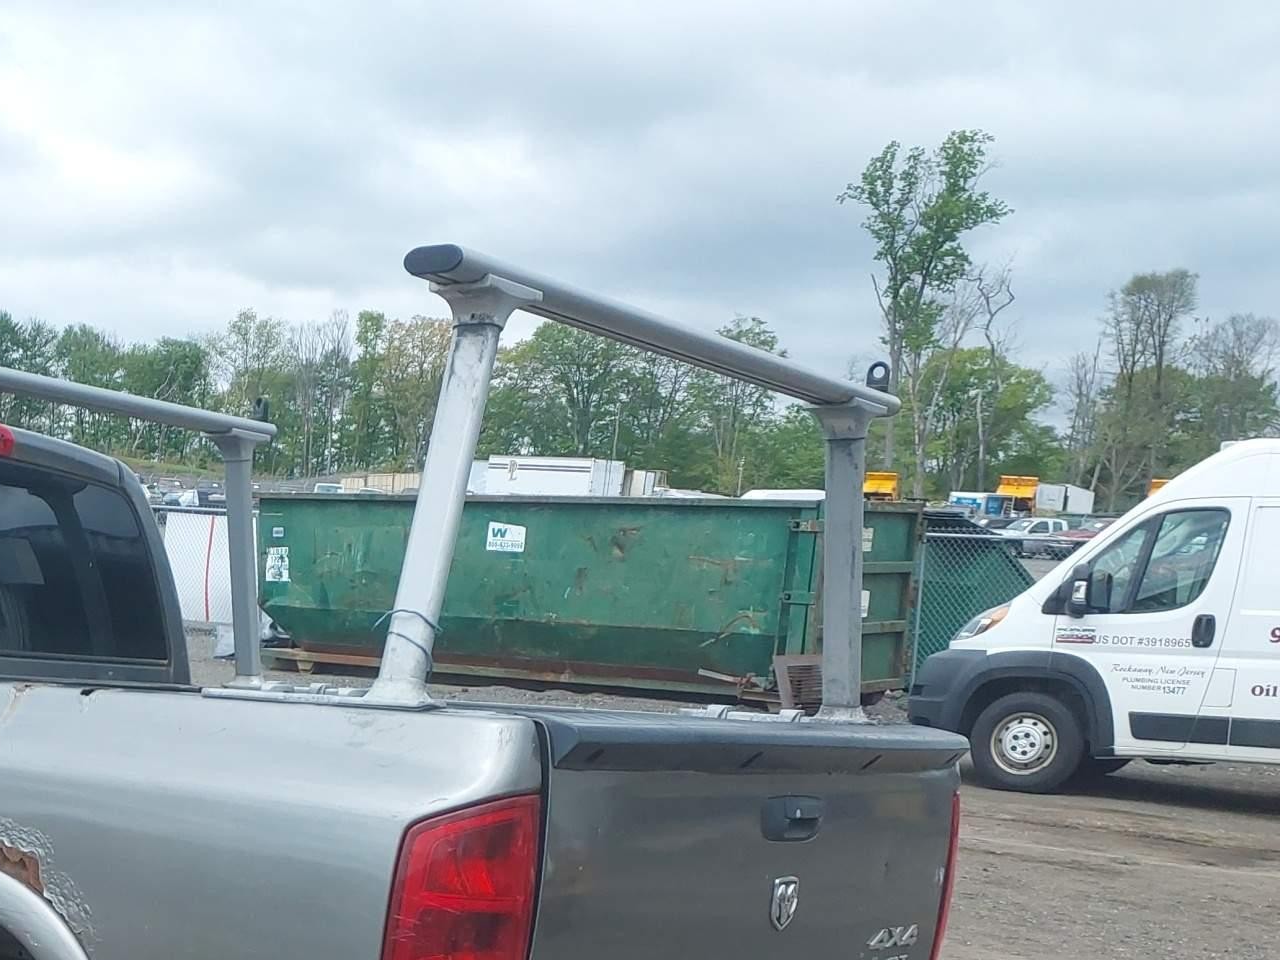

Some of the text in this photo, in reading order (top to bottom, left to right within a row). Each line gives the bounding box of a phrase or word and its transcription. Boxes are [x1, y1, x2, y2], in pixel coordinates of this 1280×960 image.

[1093, 634, 1110, 644] US
[1112, 635, 1136, 645] DOT
[1137, 637, 1191, 648] #3918965
[1156, 665, 1176, 675] New
[1177, 666, 1206, 678] Jersey
[1122, 676, 1159, 685] PLUMBING
[1163, 686, 1186, 695] 13477
[1251, 684, 1278, 697] Oil
